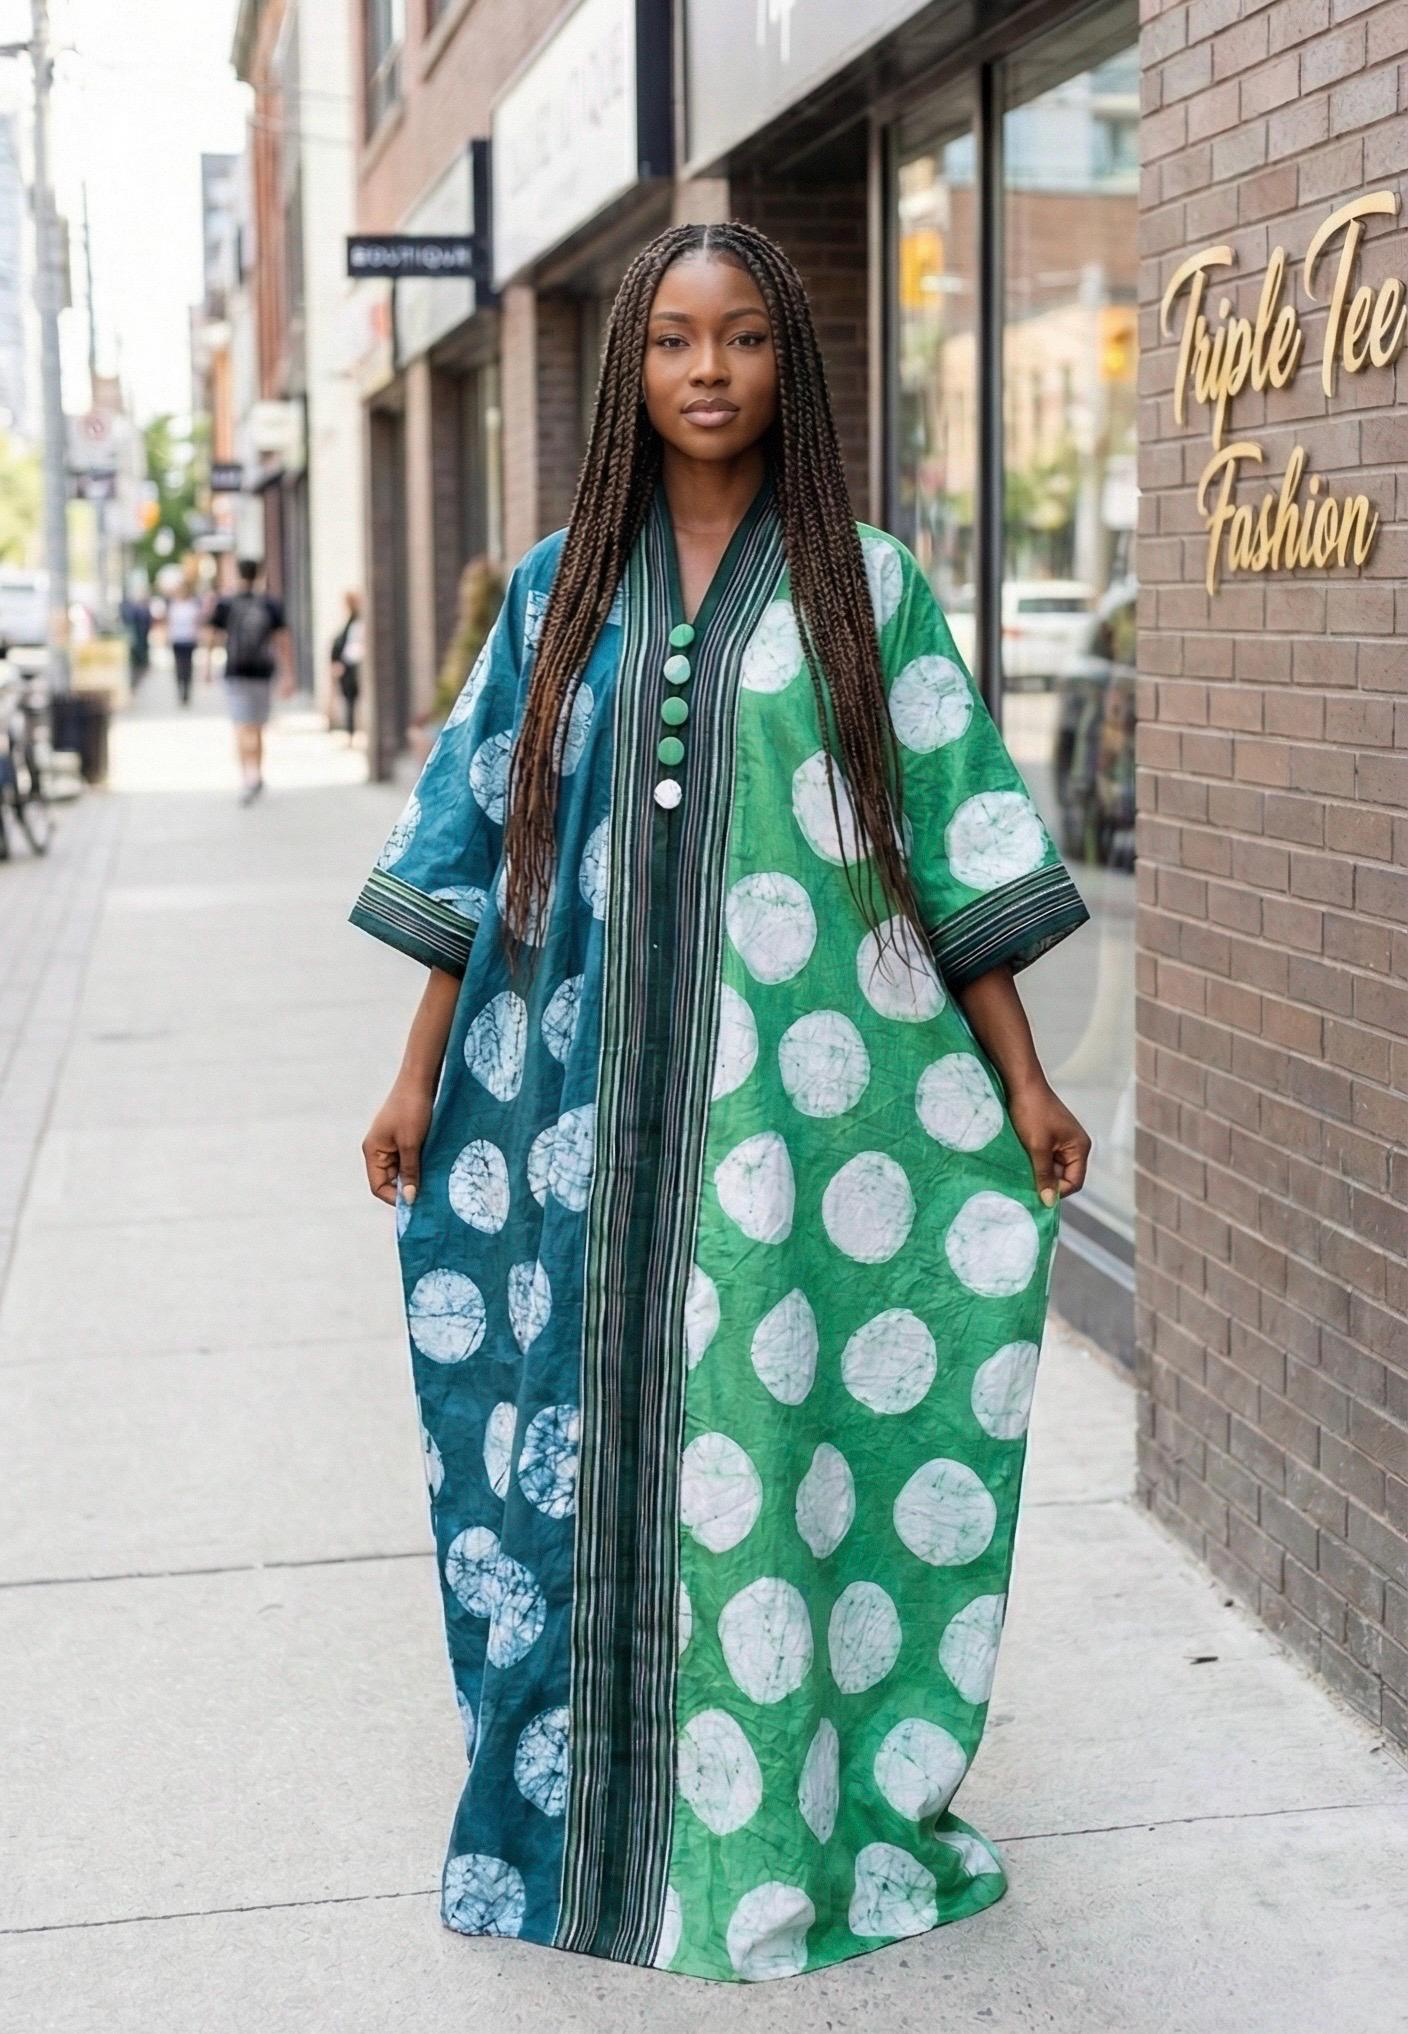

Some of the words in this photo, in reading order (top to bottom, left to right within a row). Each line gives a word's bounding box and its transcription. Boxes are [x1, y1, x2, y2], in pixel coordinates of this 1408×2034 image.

[1160, 245, 1302, 450] Triple
[1304, 190, 1408, 398] Tee
[1197, 442, 1380, 596] Fashion
